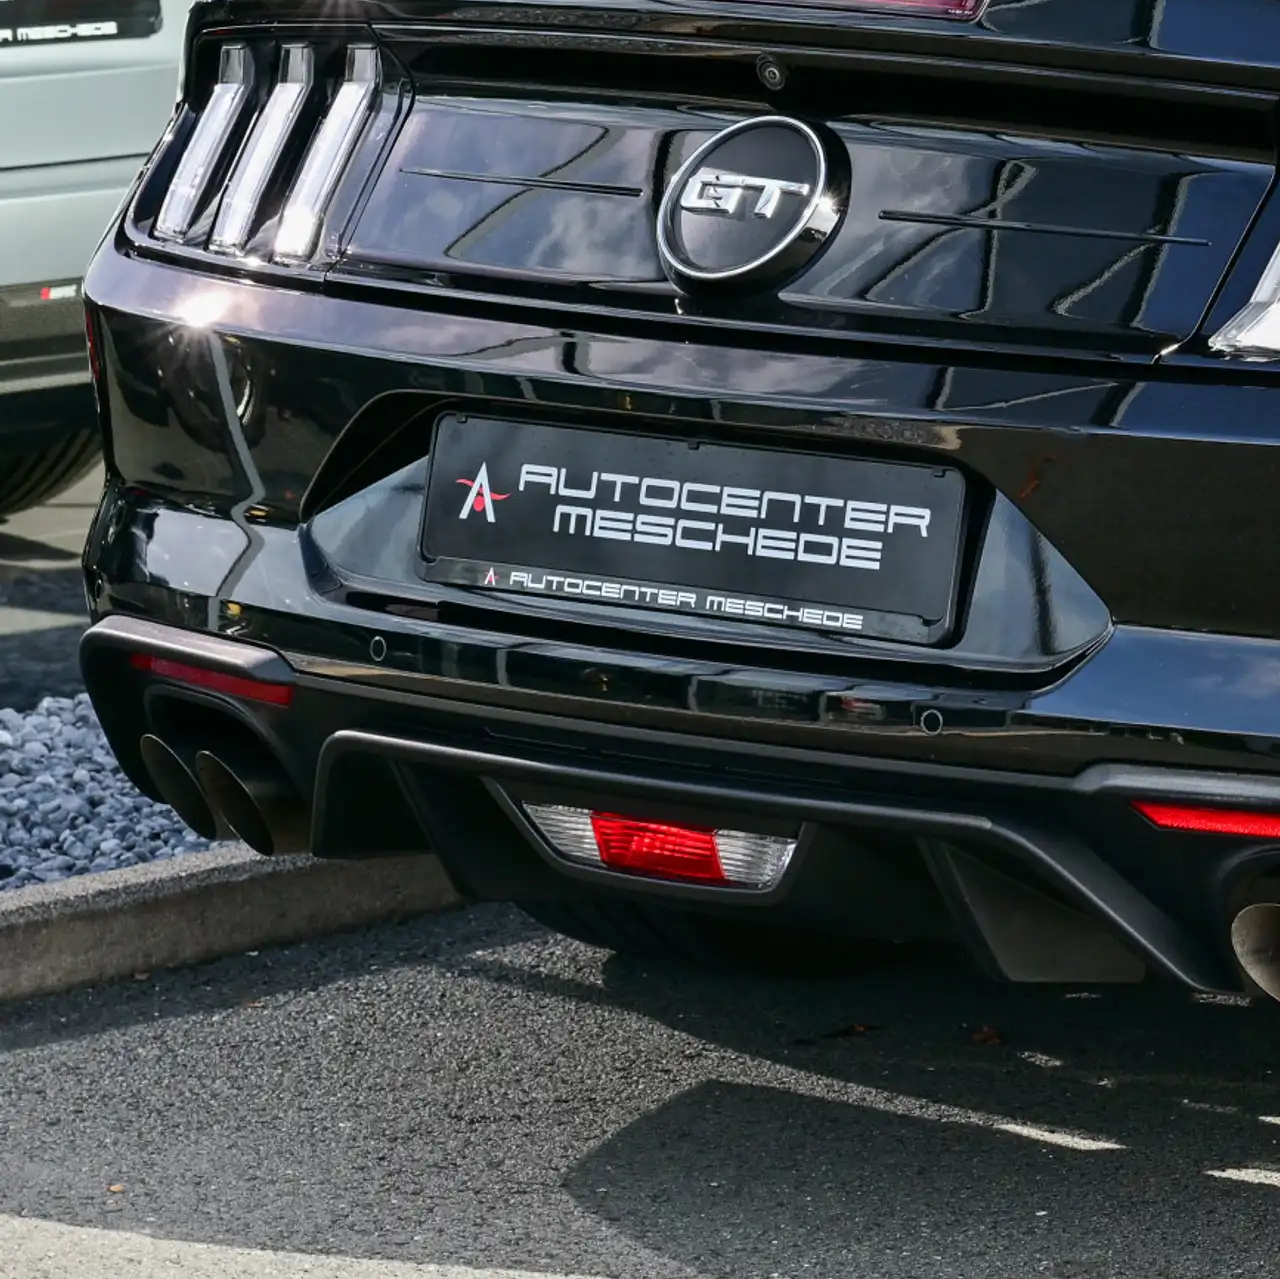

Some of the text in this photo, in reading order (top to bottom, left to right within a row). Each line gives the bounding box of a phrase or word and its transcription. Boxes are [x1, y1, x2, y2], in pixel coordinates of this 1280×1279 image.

[681, 167, 811, 219] GT
[518, 463, 932, 538] AUTOCENTER
[552, 504, 883, 571] MESCHEDE
[509, 571, 697, 608] AUTOCENTER
[705, 595, 864, 630] MESCHEDE
